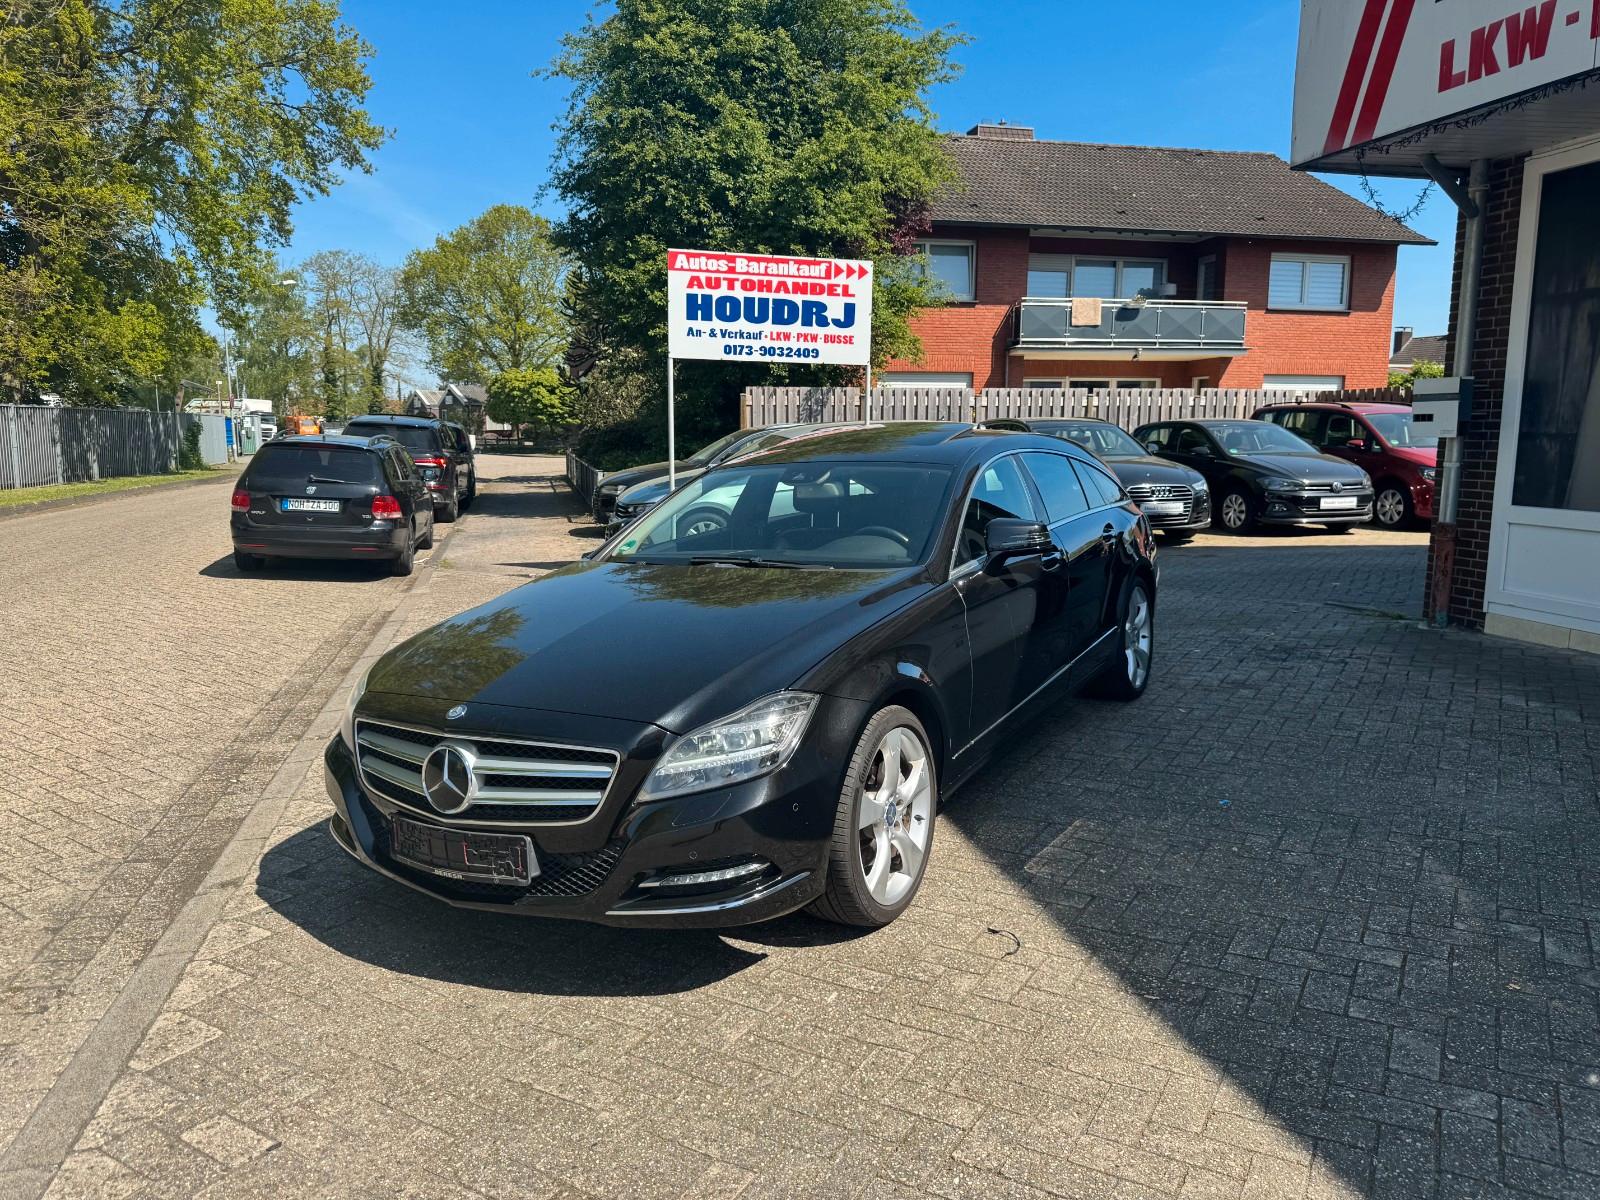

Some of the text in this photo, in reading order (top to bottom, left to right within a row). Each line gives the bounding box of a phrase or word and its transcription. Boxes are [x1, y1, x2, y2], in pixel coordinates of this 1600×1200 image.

[674, 254, 829, 277] Autos-Barankauf
[686, 275, 856, 298] AUTOHANDEL
[686, 293, 856, 329] HOUDRJ
[686, 326, 706, 338] An-
[708, 328, 718, 338] &
[719, 328, 764, 341] Verkauf
[823, 333, 855, 345] BUSSE
[723, 344, 820, 359] 0173-9032409
[288, 499, 305, 509] NOH
